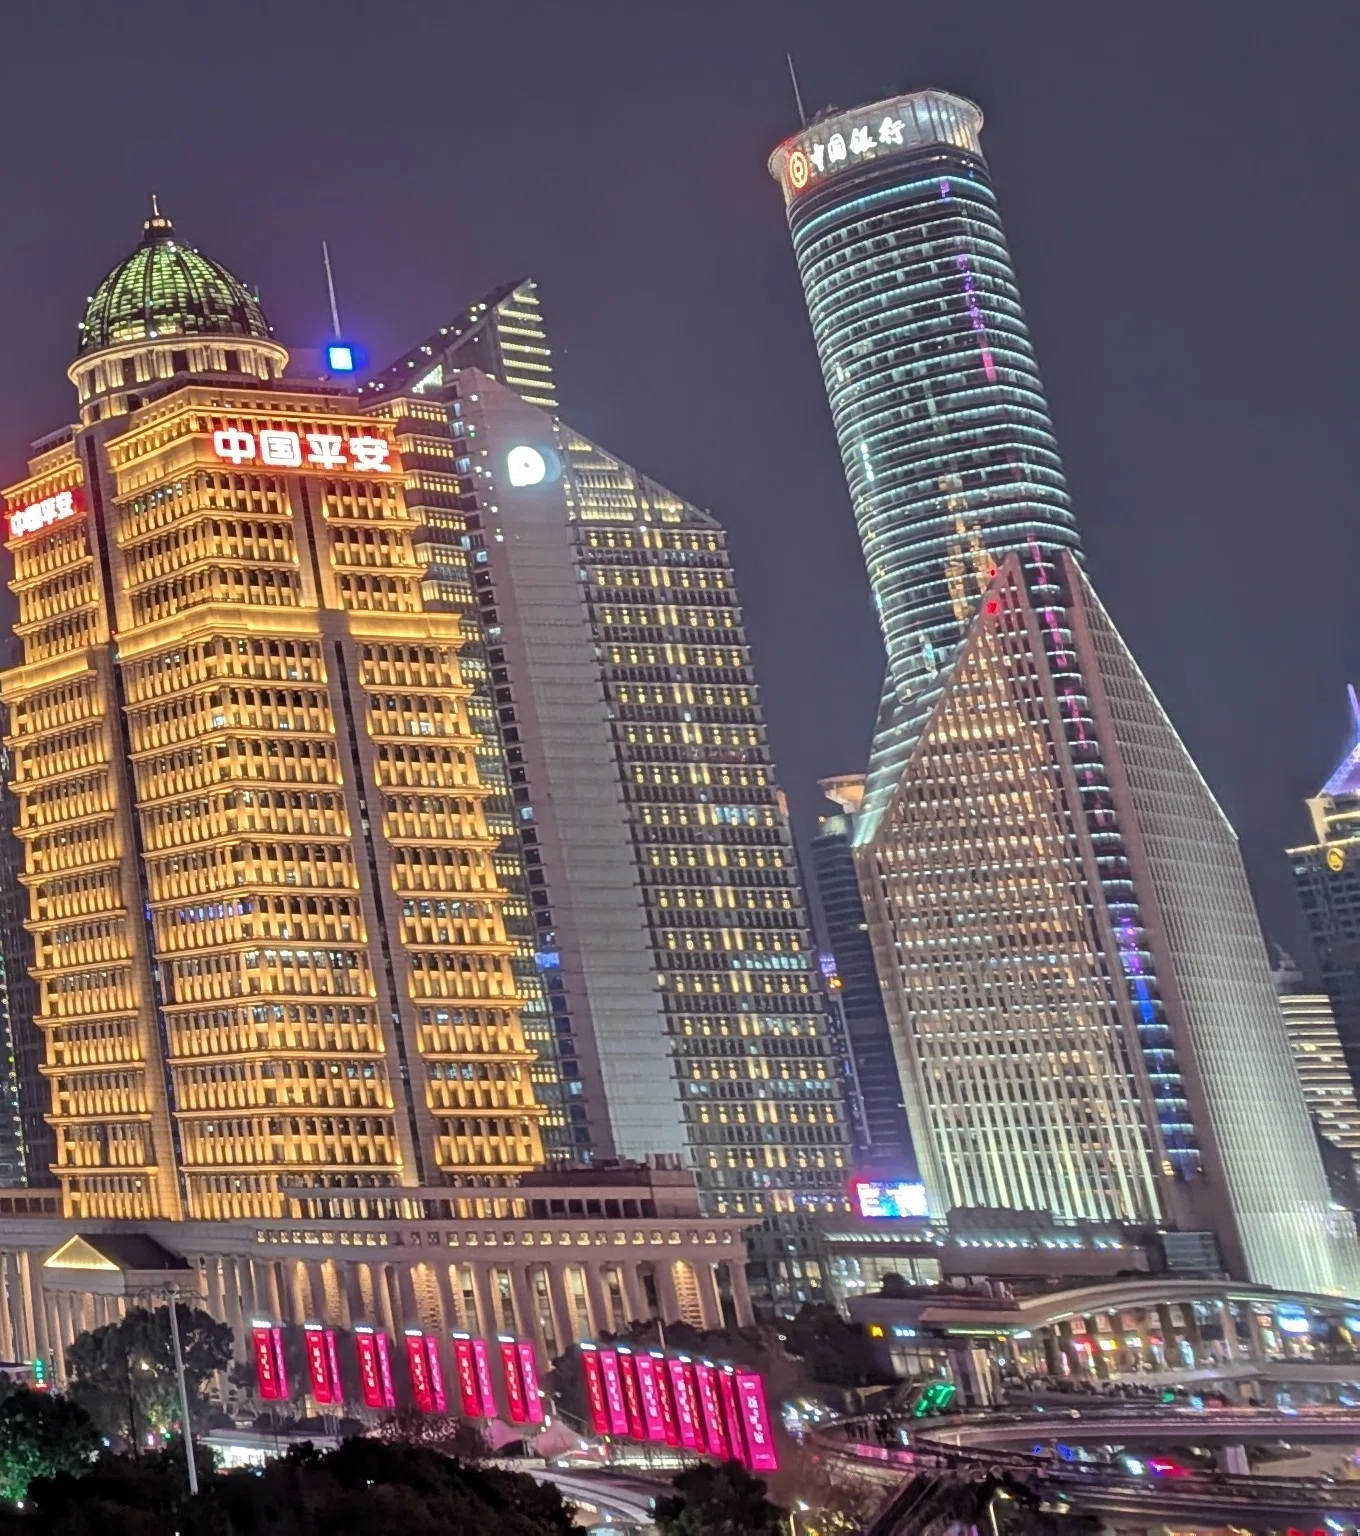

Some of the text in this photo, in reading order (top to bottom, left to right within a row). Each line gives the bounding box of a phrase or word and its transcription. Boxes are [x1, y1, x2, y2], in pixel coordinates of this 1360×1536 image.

[810, 116, 906, 172] 中国银行
[213, 427, 392, 472] 中国平安
[11, 492, 73, 536] 中国平安
